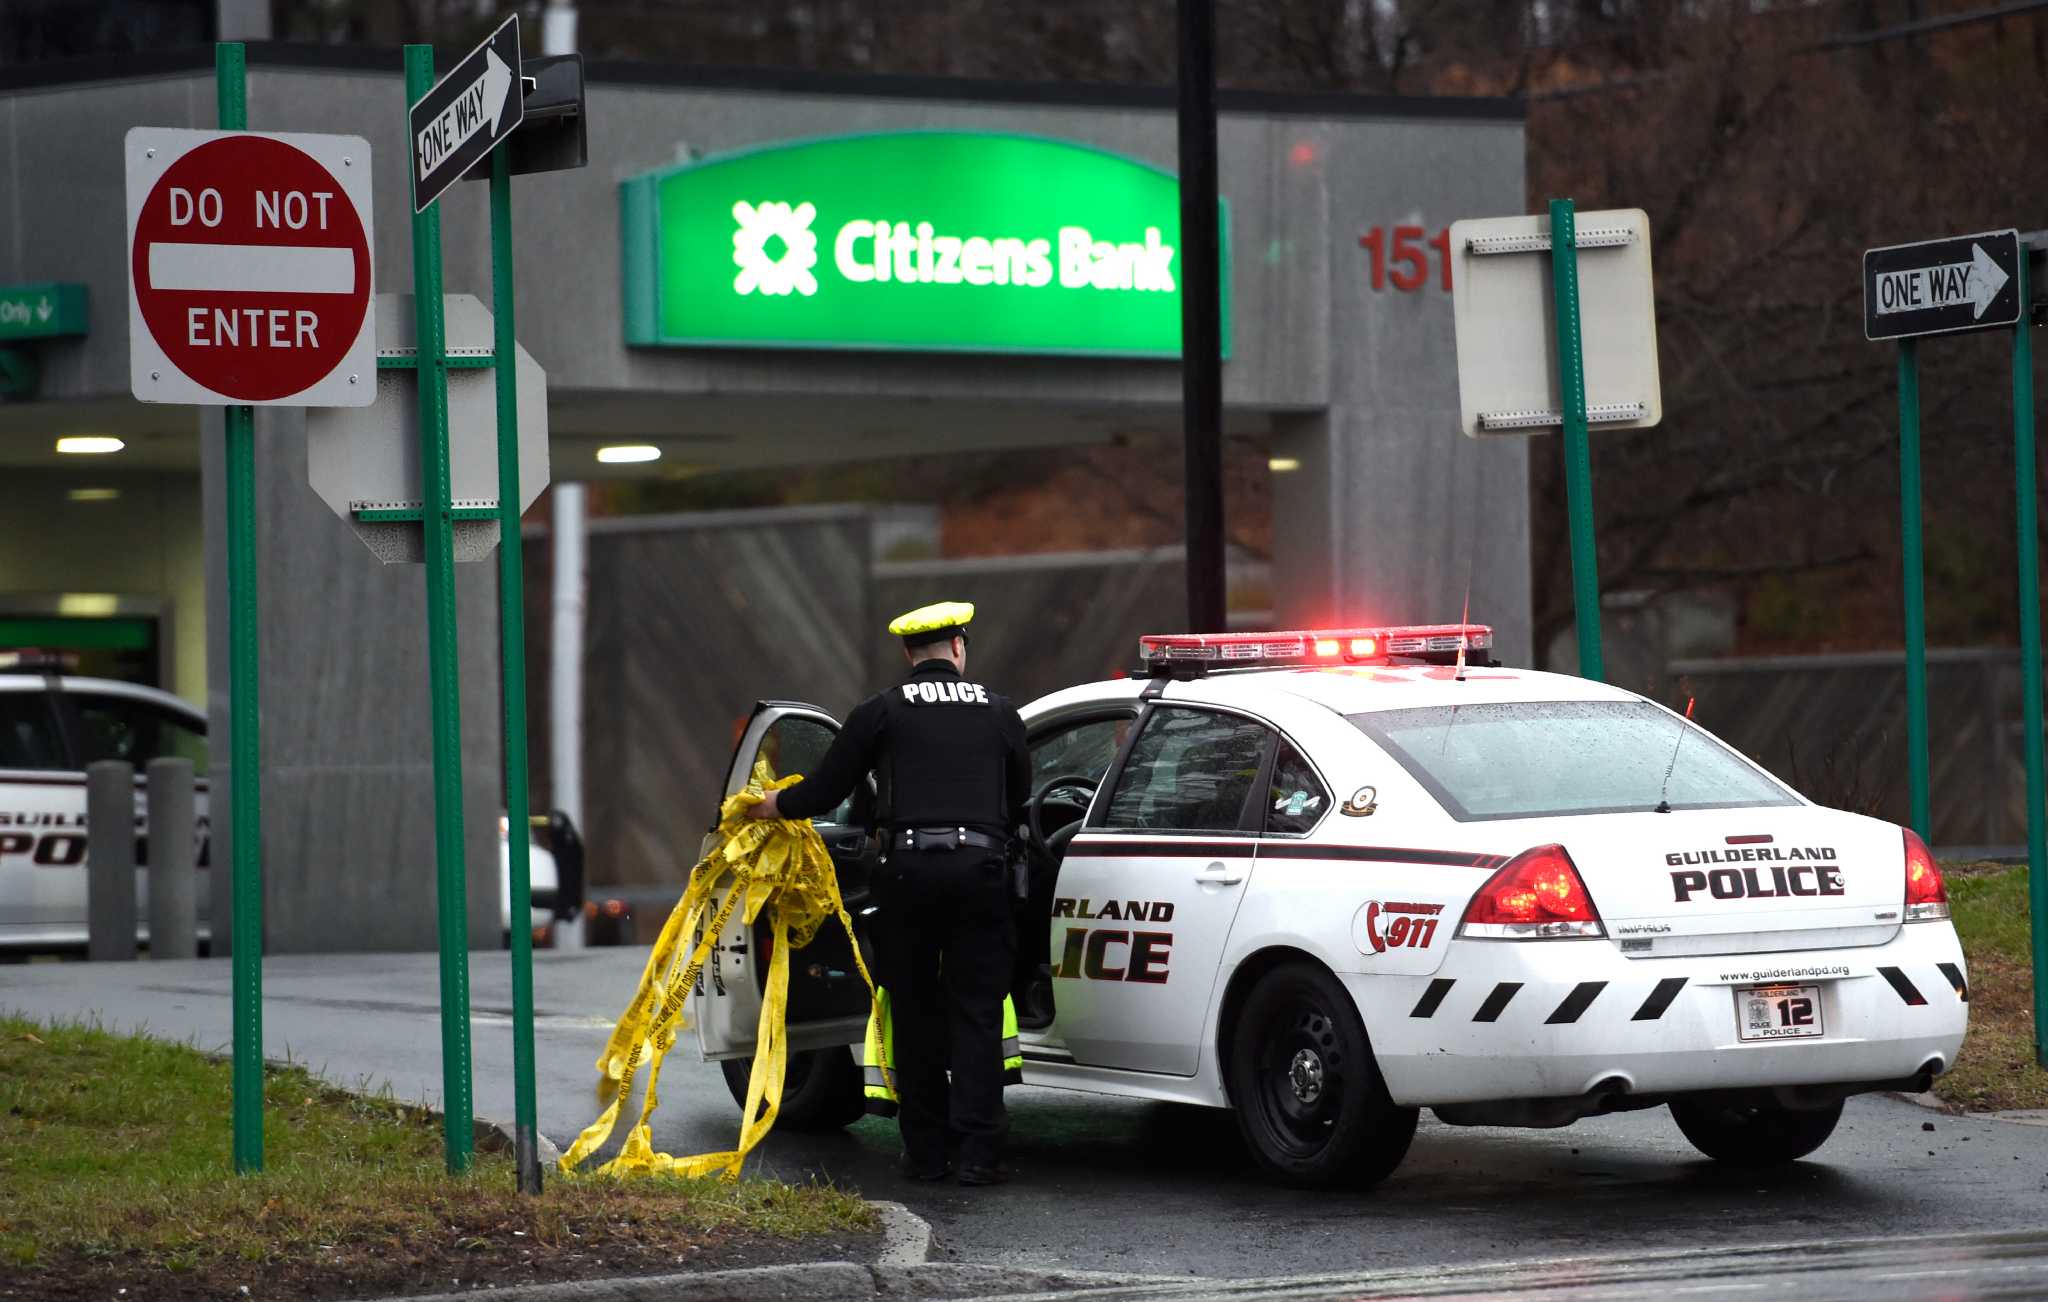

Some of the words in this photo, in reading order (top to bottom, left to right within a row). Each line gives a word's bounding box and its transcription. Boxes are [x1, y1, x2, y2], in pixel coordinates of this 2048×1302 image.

[423, 111, 452, 170] ONE
[456, 80, 485, 140] WAY
[170, 187, 223, 228] DO
[255, 190, 334, 230] NOT
[834, 220, 1053, 288] Citizens
[1058, 226, 1176, 293] Bank
[1358, 226, 1454, 292] 151
[1881, 273, 1921, 308] ONE
[1929, 265, 1971, 302] WAY
[188, 308, 320, 349] ENTER
[902, 682, 988, 703] POLICE
[1665, 847, 1837, 866] GUILDERLAND
[1669, 866, 1845, 903] POLICE
[1387, 916, 1439, 948] 911
[1051, 928, 1174, 984] ICE
[1720, 965, 1850, 982] www.guilderlandpd.org
[1763, 1028, 1801, 1036] POLICE
[1777, 998, 1814, 1027] 12
